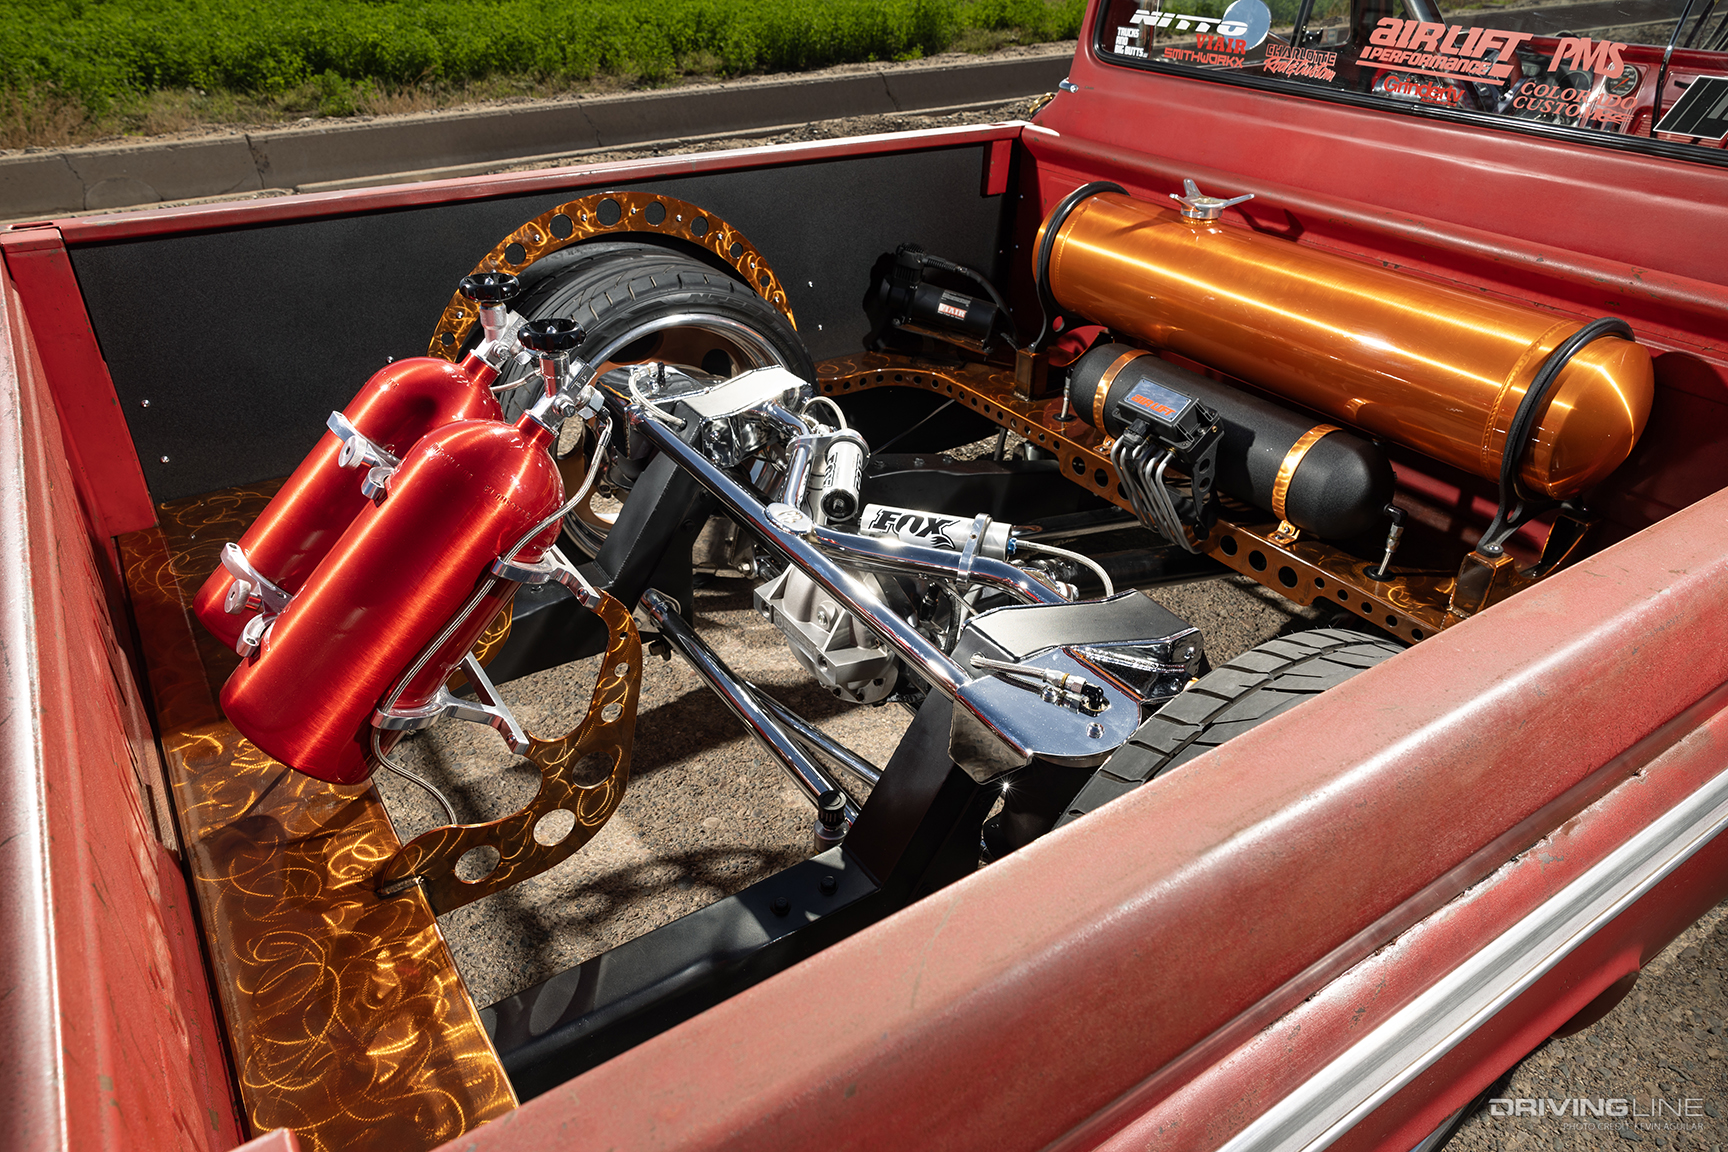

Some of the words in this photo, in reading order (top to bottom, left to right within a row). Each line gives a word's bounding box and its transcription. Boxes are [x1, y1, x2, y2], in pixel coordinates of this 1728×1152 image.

[1115, 36, 1129, 46] AND
[1117, 26, 1140, 38] TRUCKS
[1196, 34, 1247, 55] VIAIR
[1265, 43, 1338, 67] CHARLOTTE
[1164, 47, 1245, 69] SMITHWORKX
[1547, 37, 1628, 79] PMS
[1520, 81, 1638, 110] COLORADO
[872, 508, 954, 538] FOX
